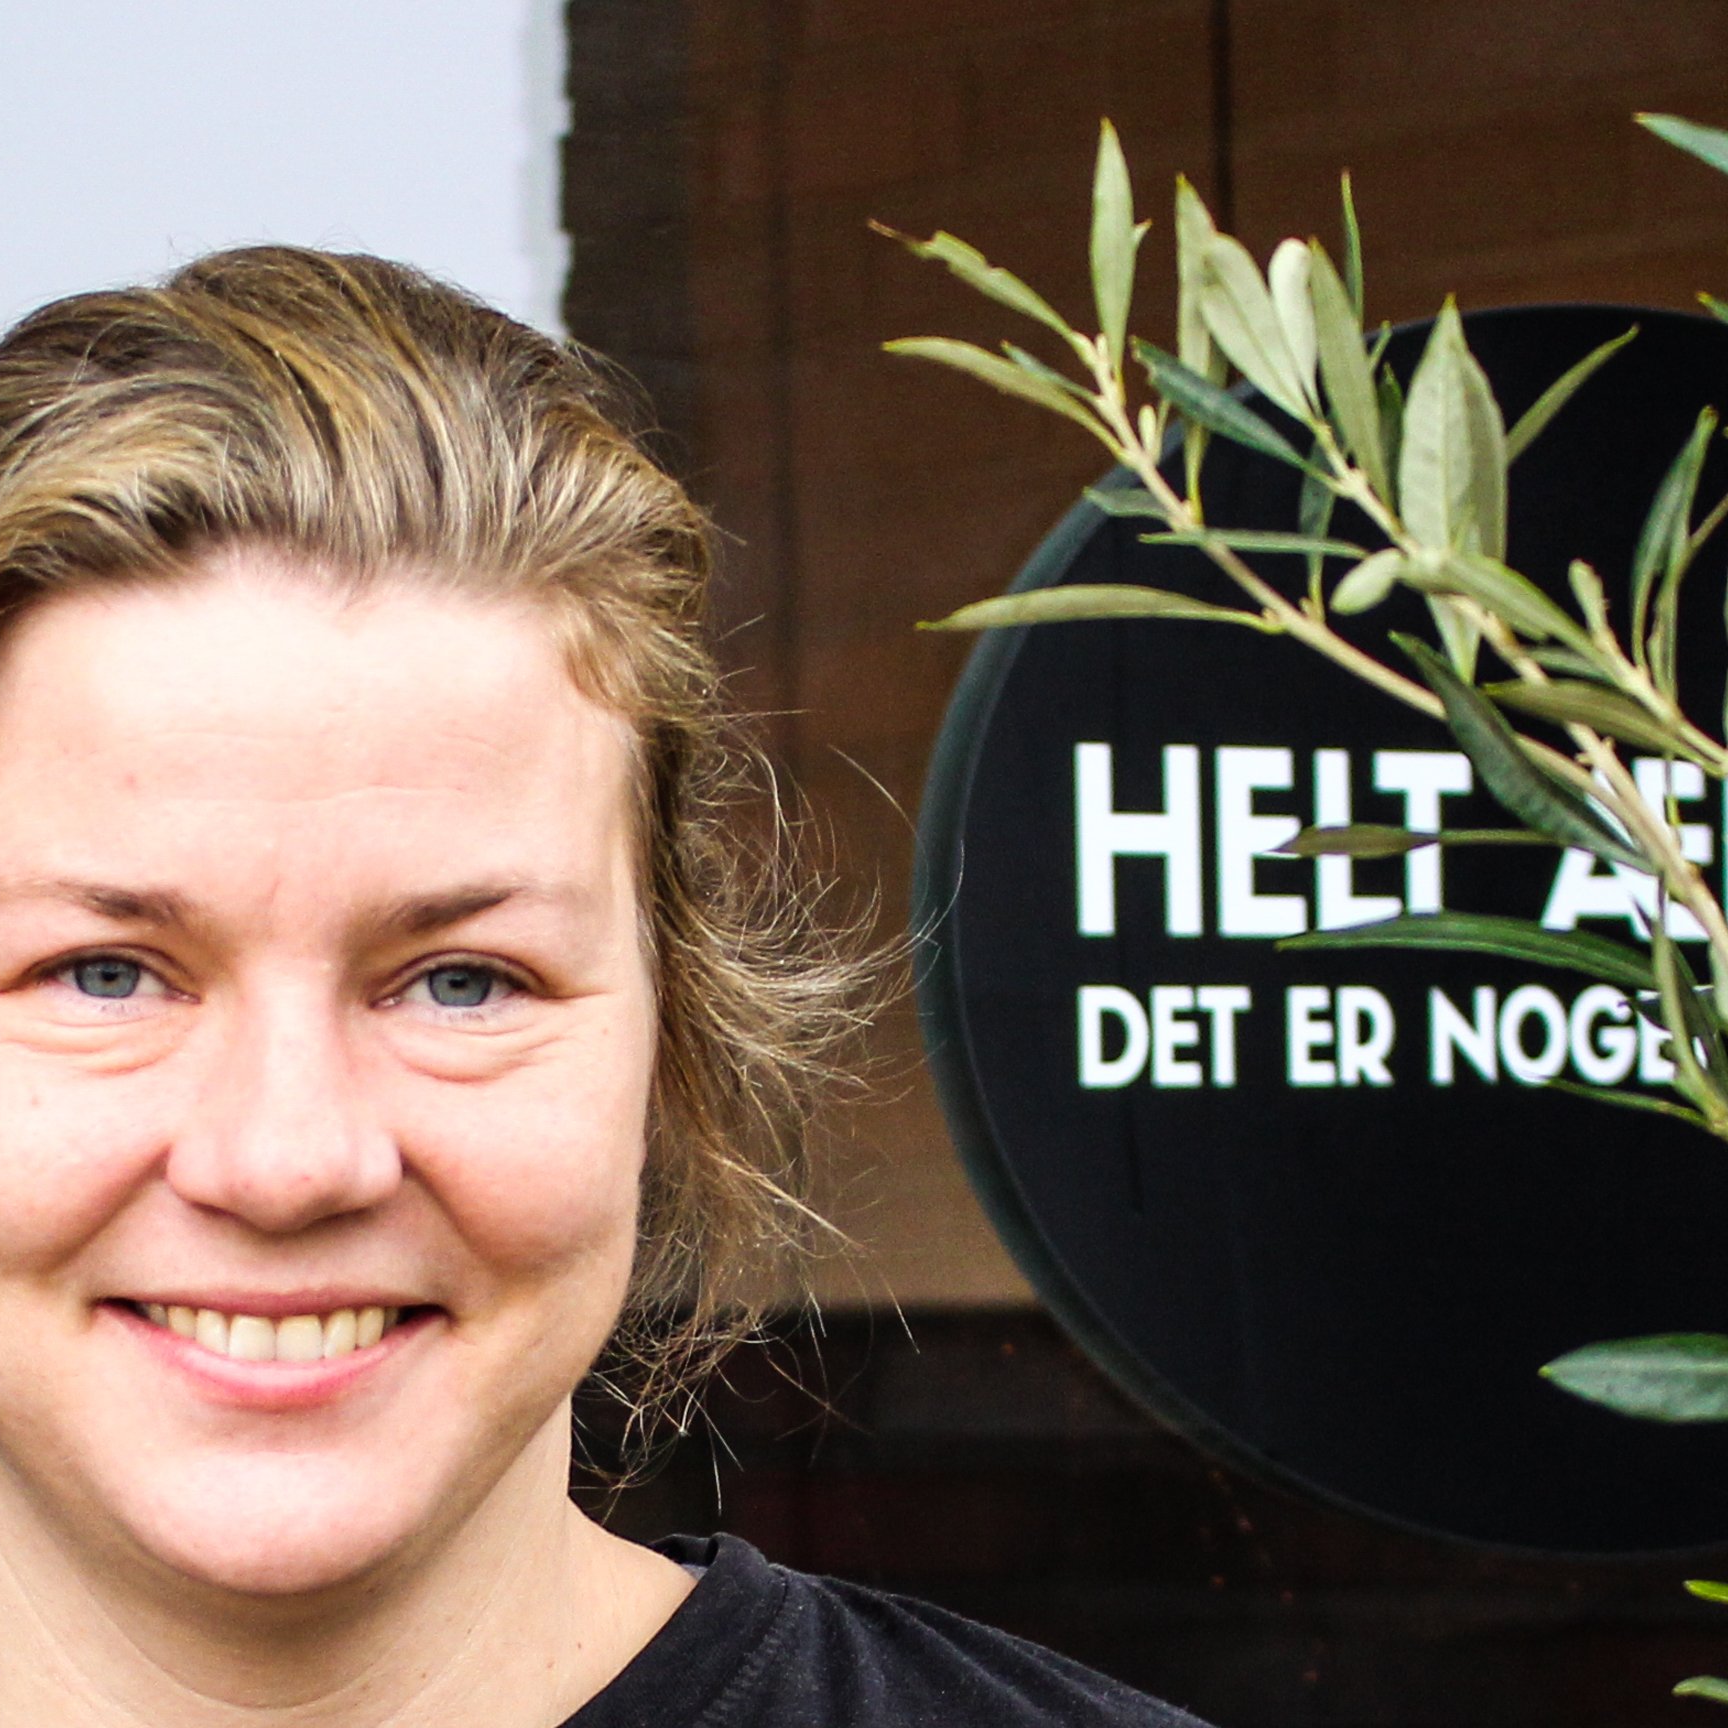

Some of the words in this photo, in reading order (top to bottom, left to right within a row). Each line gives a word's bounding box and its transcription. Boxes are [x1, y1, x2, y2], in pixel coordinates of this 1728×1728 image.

[1075, 742, 1472, 937] HELT
[1077, 985, 1251, 1088] DET
[1286, 985, 1395, 1087] ER
[1428, 983, 1715, 1087] NOGE
